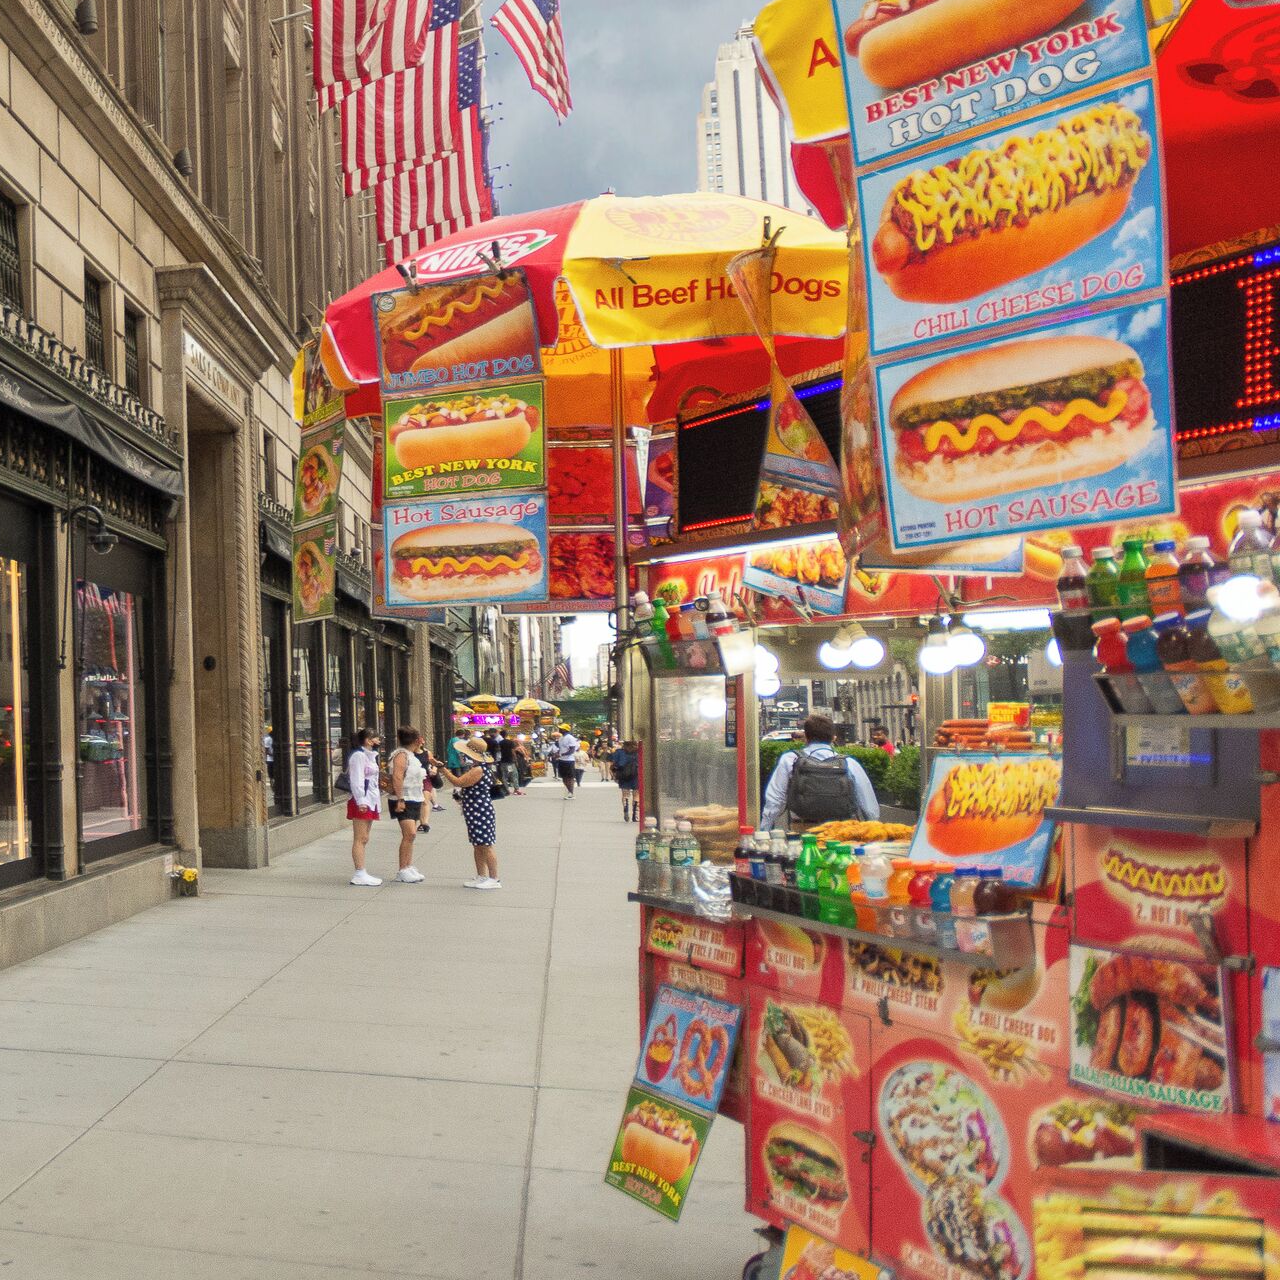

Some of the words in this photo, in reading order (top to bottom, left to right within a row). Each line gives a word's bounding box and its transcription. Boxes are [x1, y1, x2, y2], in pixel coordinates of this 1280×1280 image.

[865, 81, 938, 124] BEST
[943, 50, 1020, 96] NEW
[1023, 12, 1125, 64] YORK
[889, 91, 982, 148] HOT
[991, 50, 1101, 112] DOG
[595, 286, 624, 310] All
[632, 279, 699, 308] Beef
[706, 276, 742, 300] Ho
[913, 310, 969, 340] CHILI
[975, 282, 1074, 324] CHEESE
[1082, 264, 1145, 299] DOG
[388, 367, 449, 389] JUMBO
[451, 361, 488, 380] HOT
[492, 354, 534, 372] DOG
[391, 465, 435, 485] BEST
[440, 459, 485, 473] NEW
[486, 458, 538, 473] YORK
[424, 475, 459, 491] HOT
[462, 472, 502, 488] DOG
[394, 507, 433, 525] Hot
[441, 501, 538, 520] Sausage
[945, 505, 1001, 534] HOT
[1008, 481, 1159, 522] SAUSAGE
[980, 1010, 1002, 1031] CHILI
[1003, 1015, 1035, 1039] CHEESE
[1037, 1023, 1056, 1044] DOG
[1147, 1083, 1222, 1111] SAUSAGE
[613, 1161, 636, 1173] BEST
[636, 1166, 658, 1182] NEW
[658, 1177, 681, 1206] YORK
